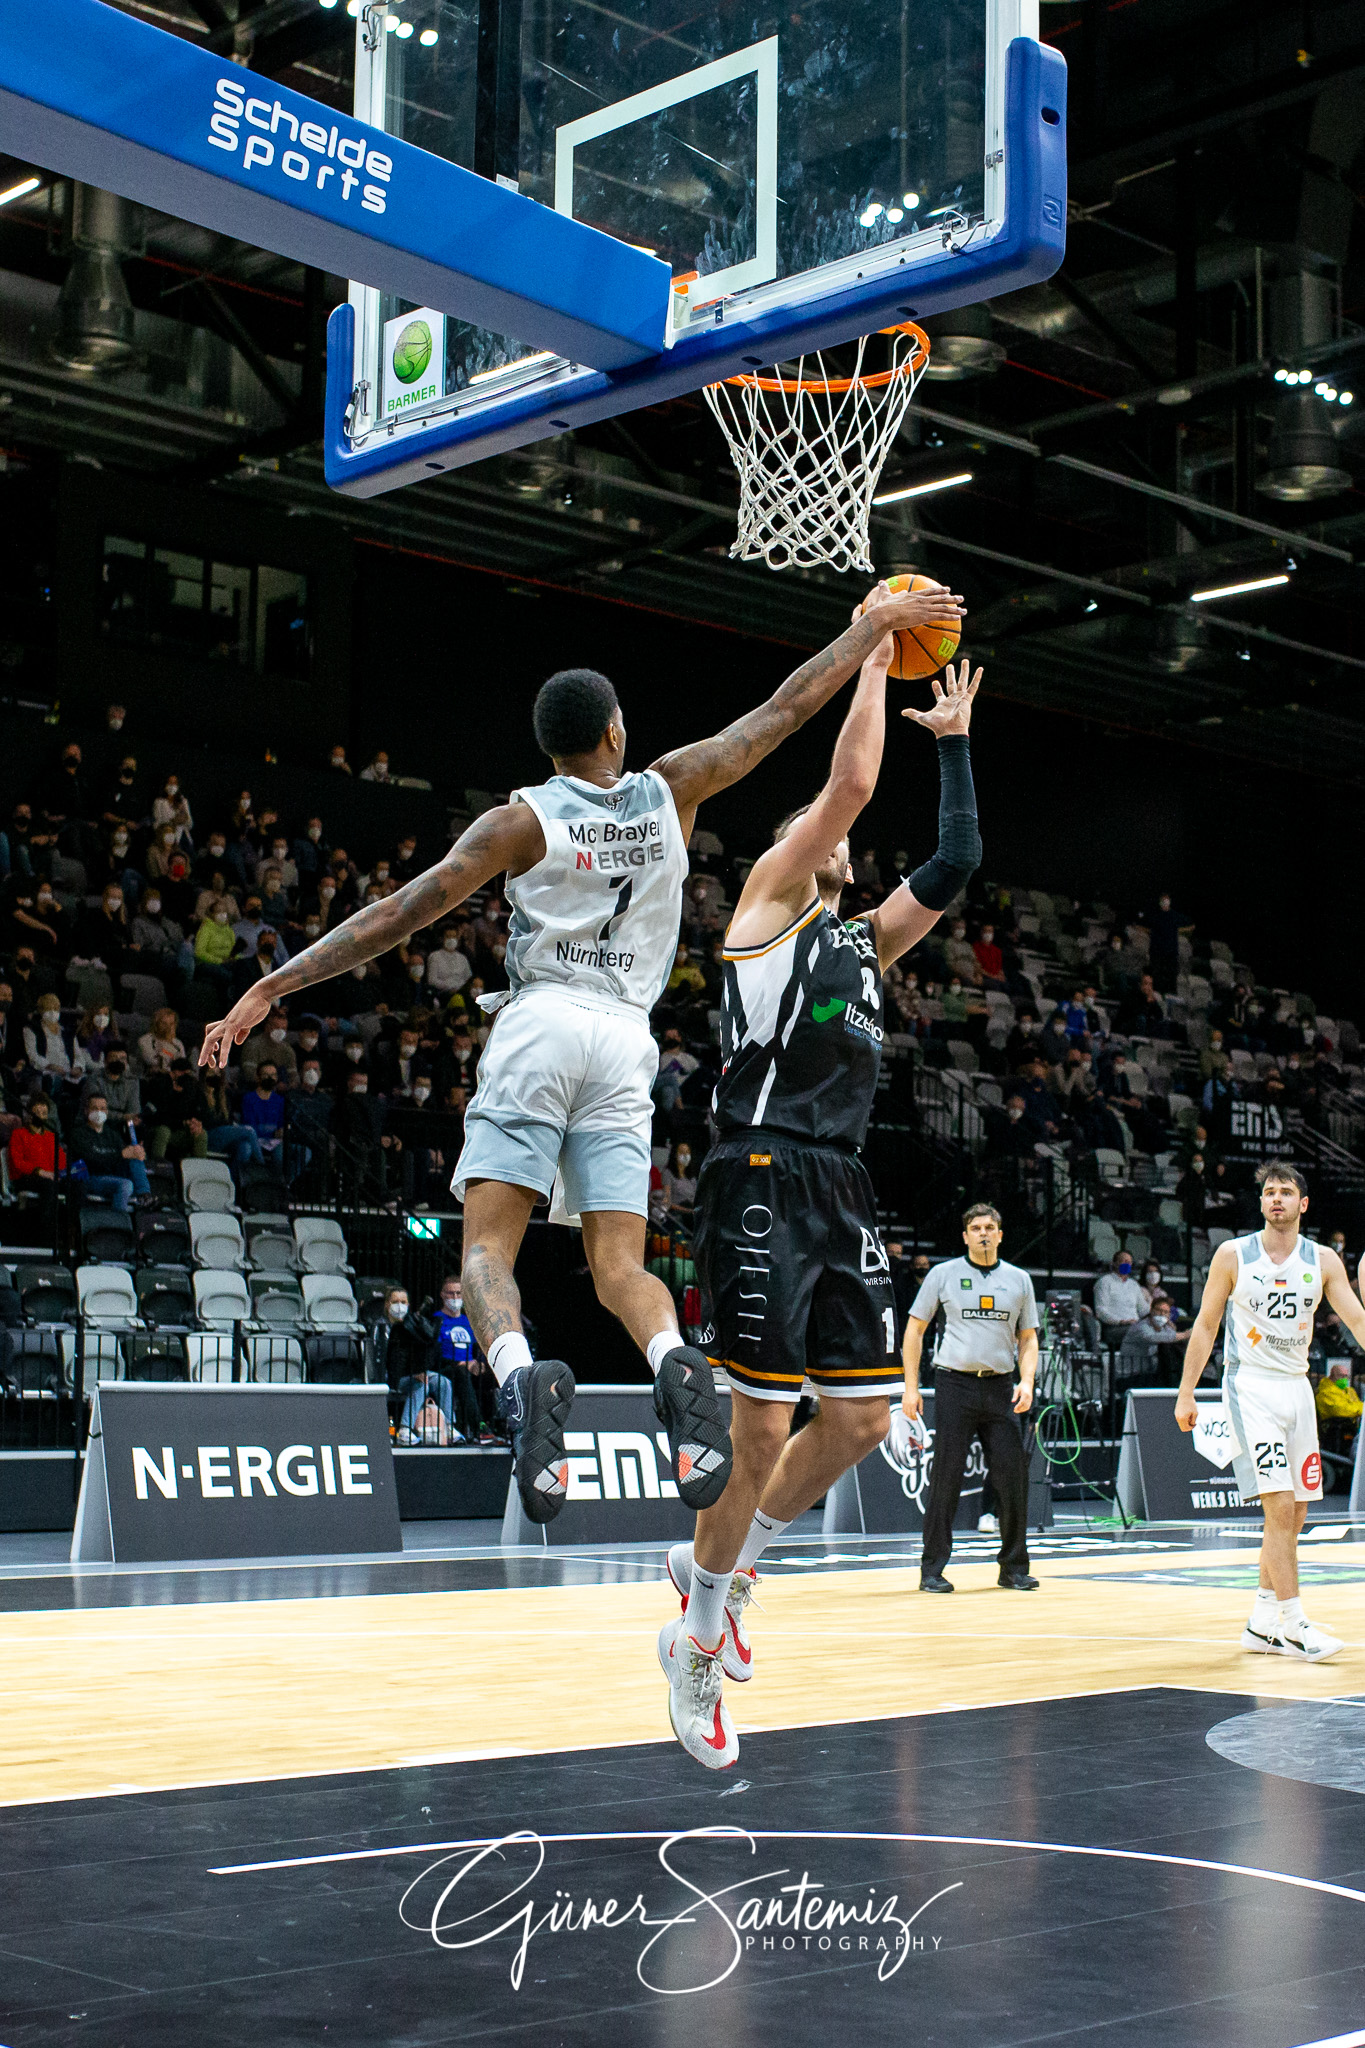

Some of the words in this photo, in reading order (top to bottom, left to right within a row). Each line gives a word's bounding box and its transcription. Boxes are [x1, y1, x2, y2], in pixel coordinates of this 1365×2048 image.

[213, 78, 393, 182] Schelde
[207, 113, 387, 214] Sports
[387, 385, 436, 412] BARMER
[568, 823, 597, 844] Mc
[598, 874, 633, 942] 7
[734, 1204, 773, 1341] OJESH
[963, 1311, 1009, 1320] BALLSIDE
[1267, 1292, 1297, 1319] 25
[1255, 1442, 1288, 1469] 25
